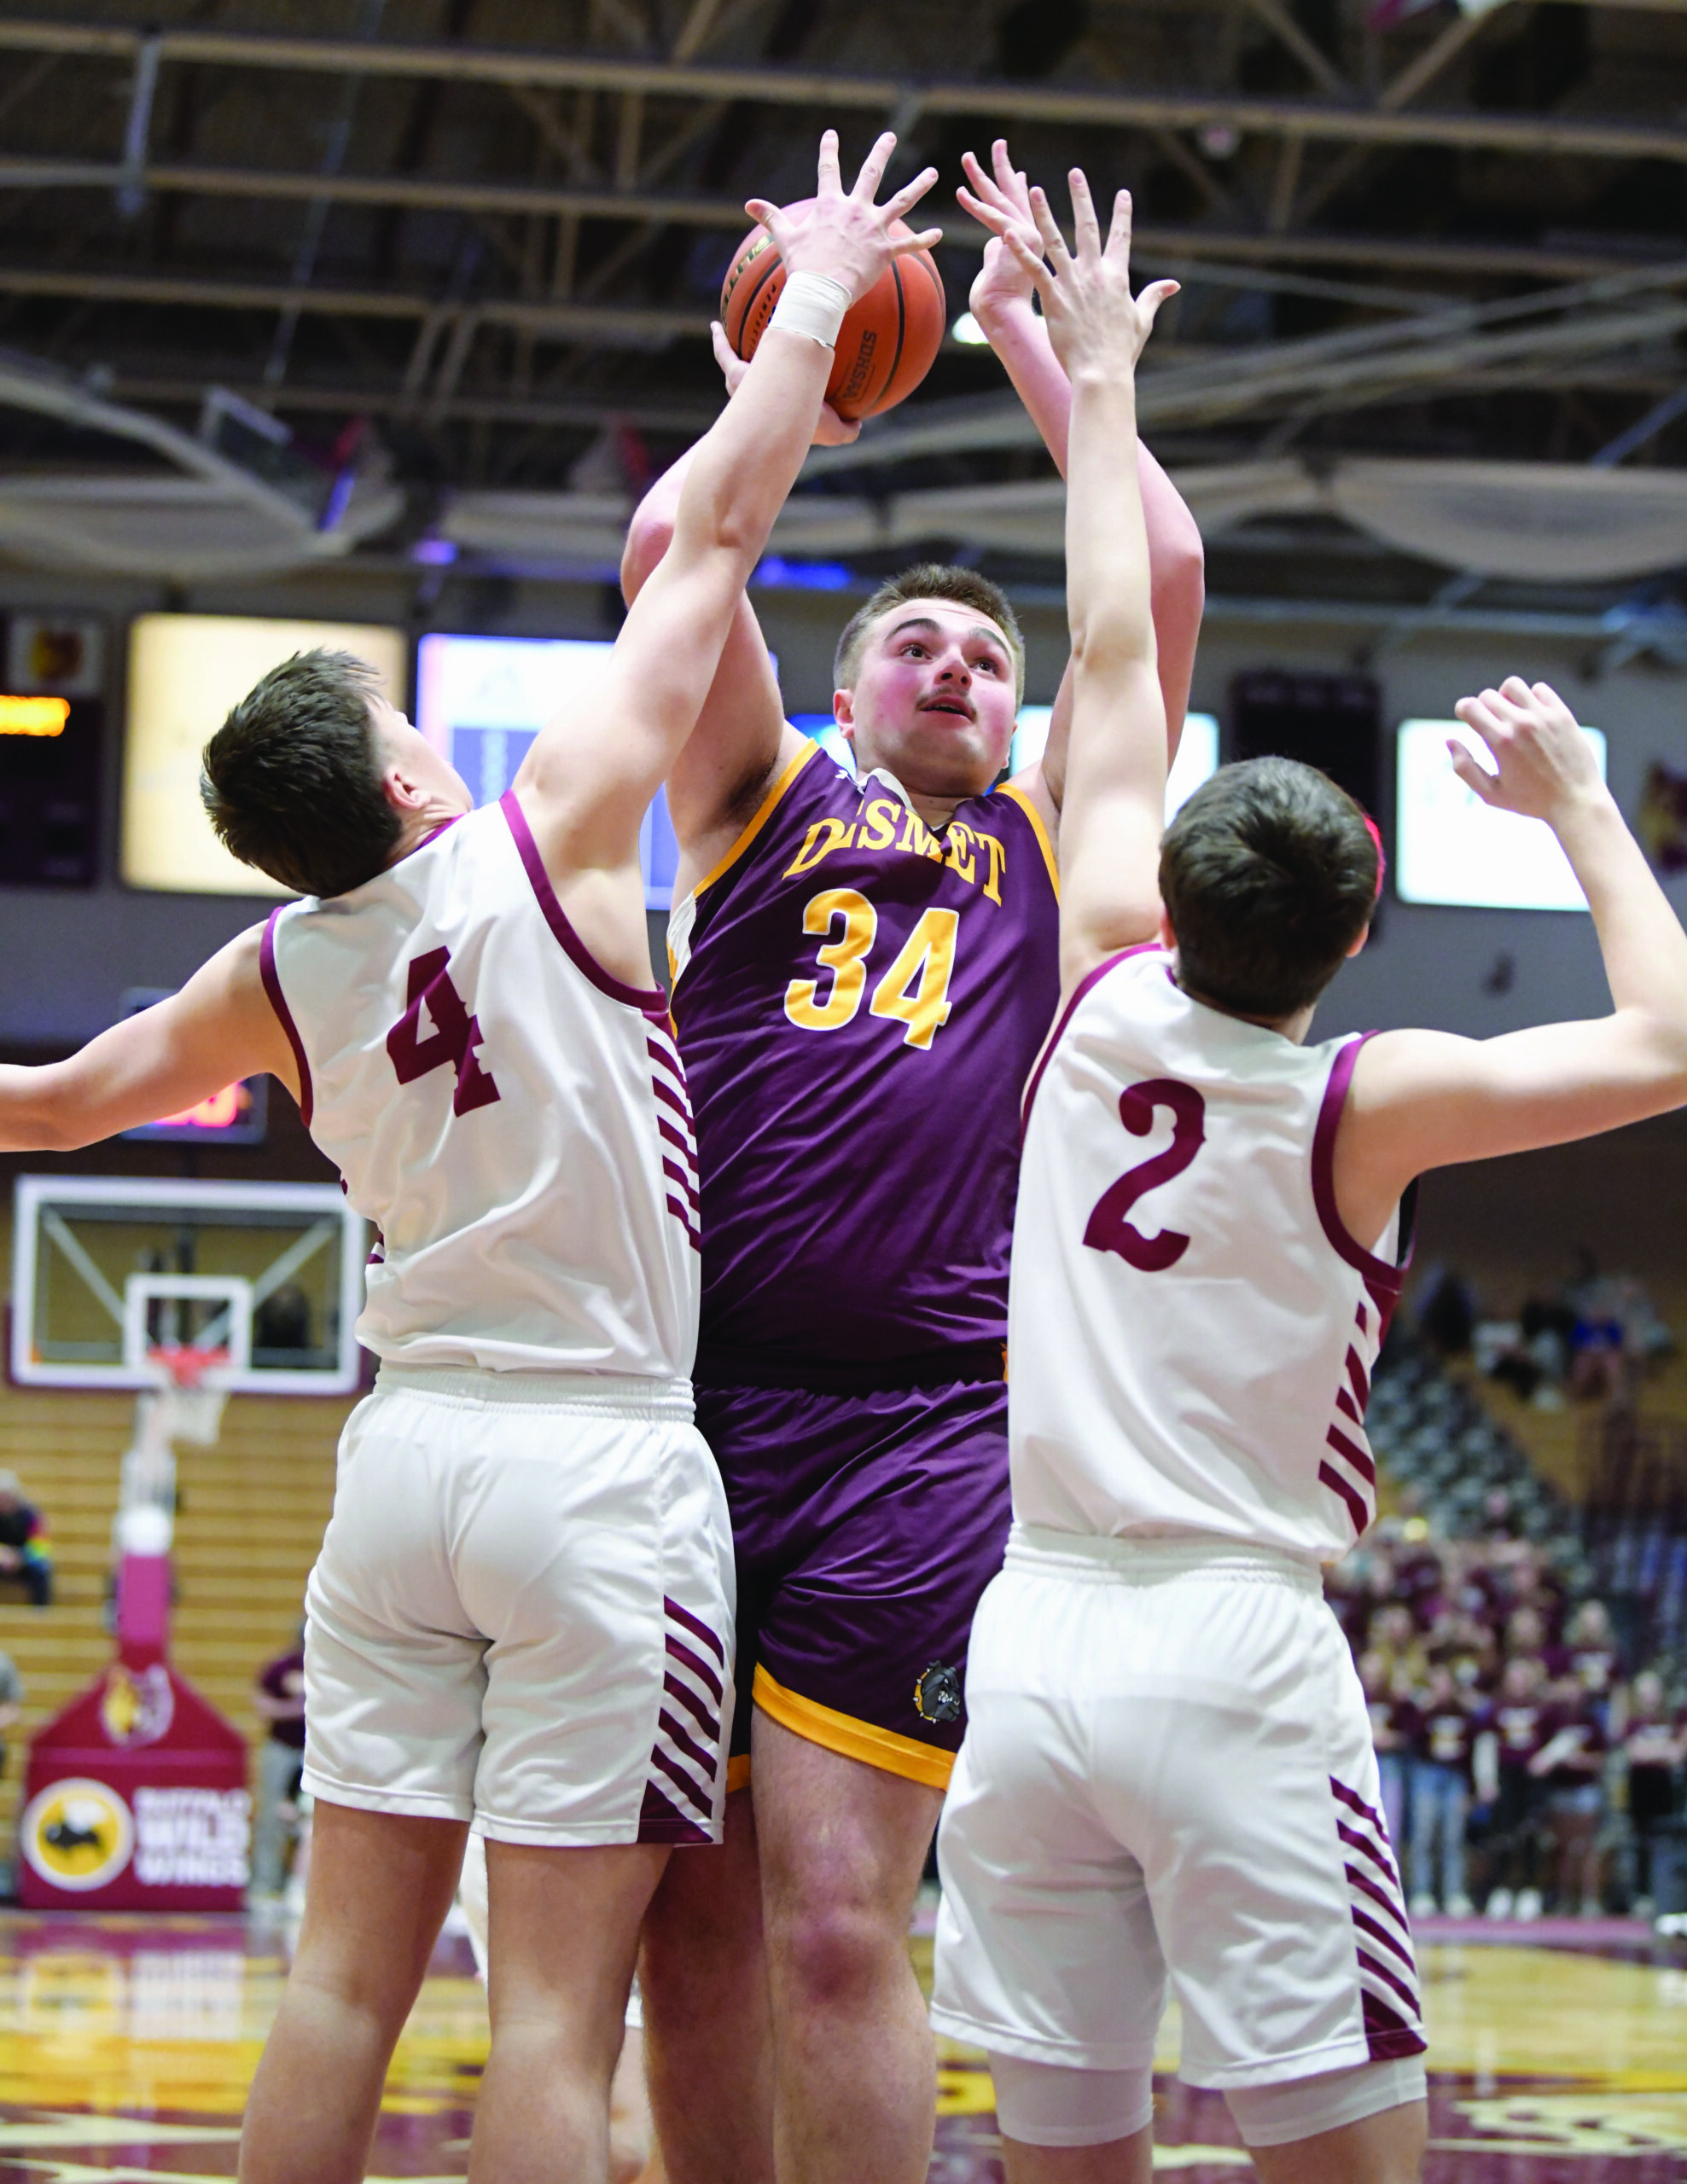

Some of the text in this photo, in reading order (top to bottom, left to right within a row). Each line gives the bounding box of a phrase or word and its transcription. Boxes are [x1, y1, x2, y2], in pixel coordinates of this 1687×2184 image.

[387, 945, 501, 1118] 4
[784, 888, 959, 1050] 34
[1082, 1078, 1207, 1272] 2
